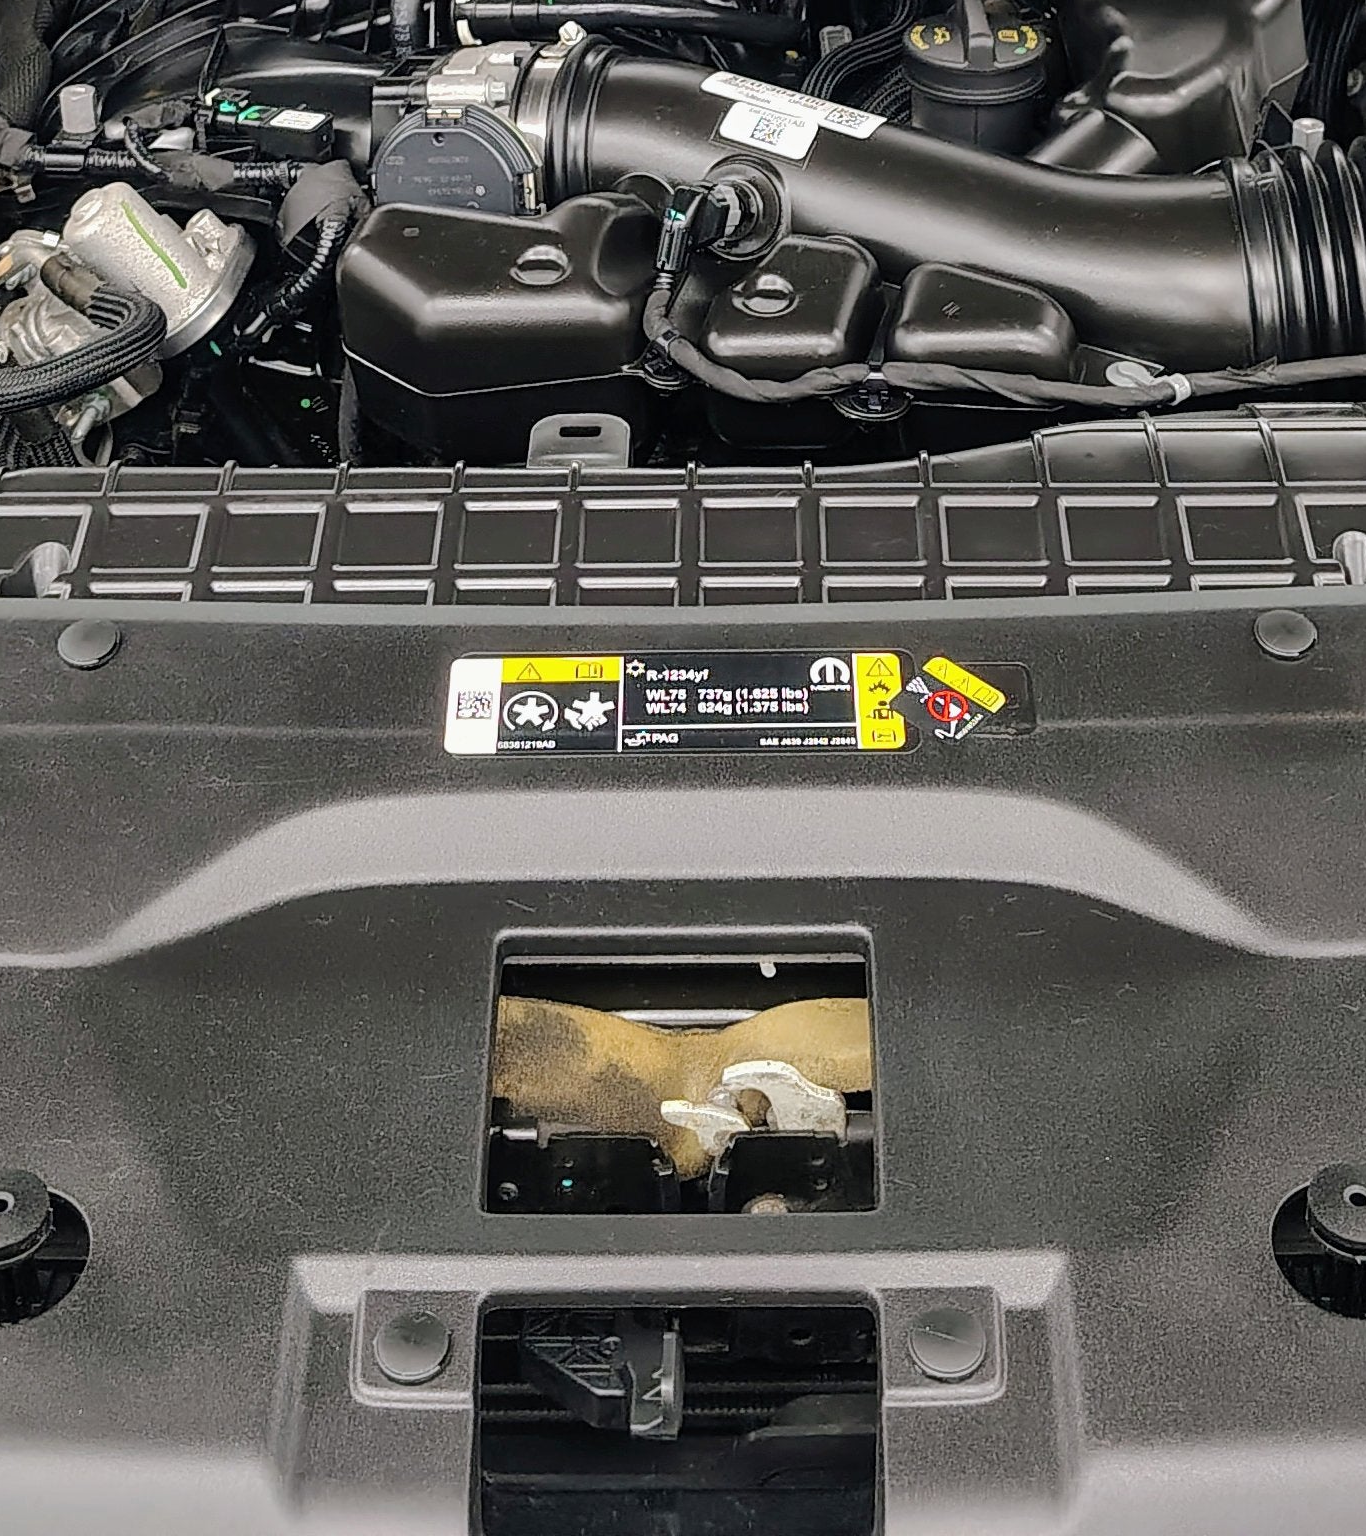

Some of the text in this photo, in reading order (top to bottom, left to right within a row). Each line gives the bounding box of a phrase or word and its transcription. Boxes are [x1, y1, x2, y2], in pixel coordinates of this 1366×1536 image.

[646, 669, 709, 683] R-1234yf
[646, 688, 809, 702] WL75 737g (1.625 lbs)
[646, 701, 809, 715] WL74 624g (1.375 lbs)
[652, 733, 679, 744] PAG
